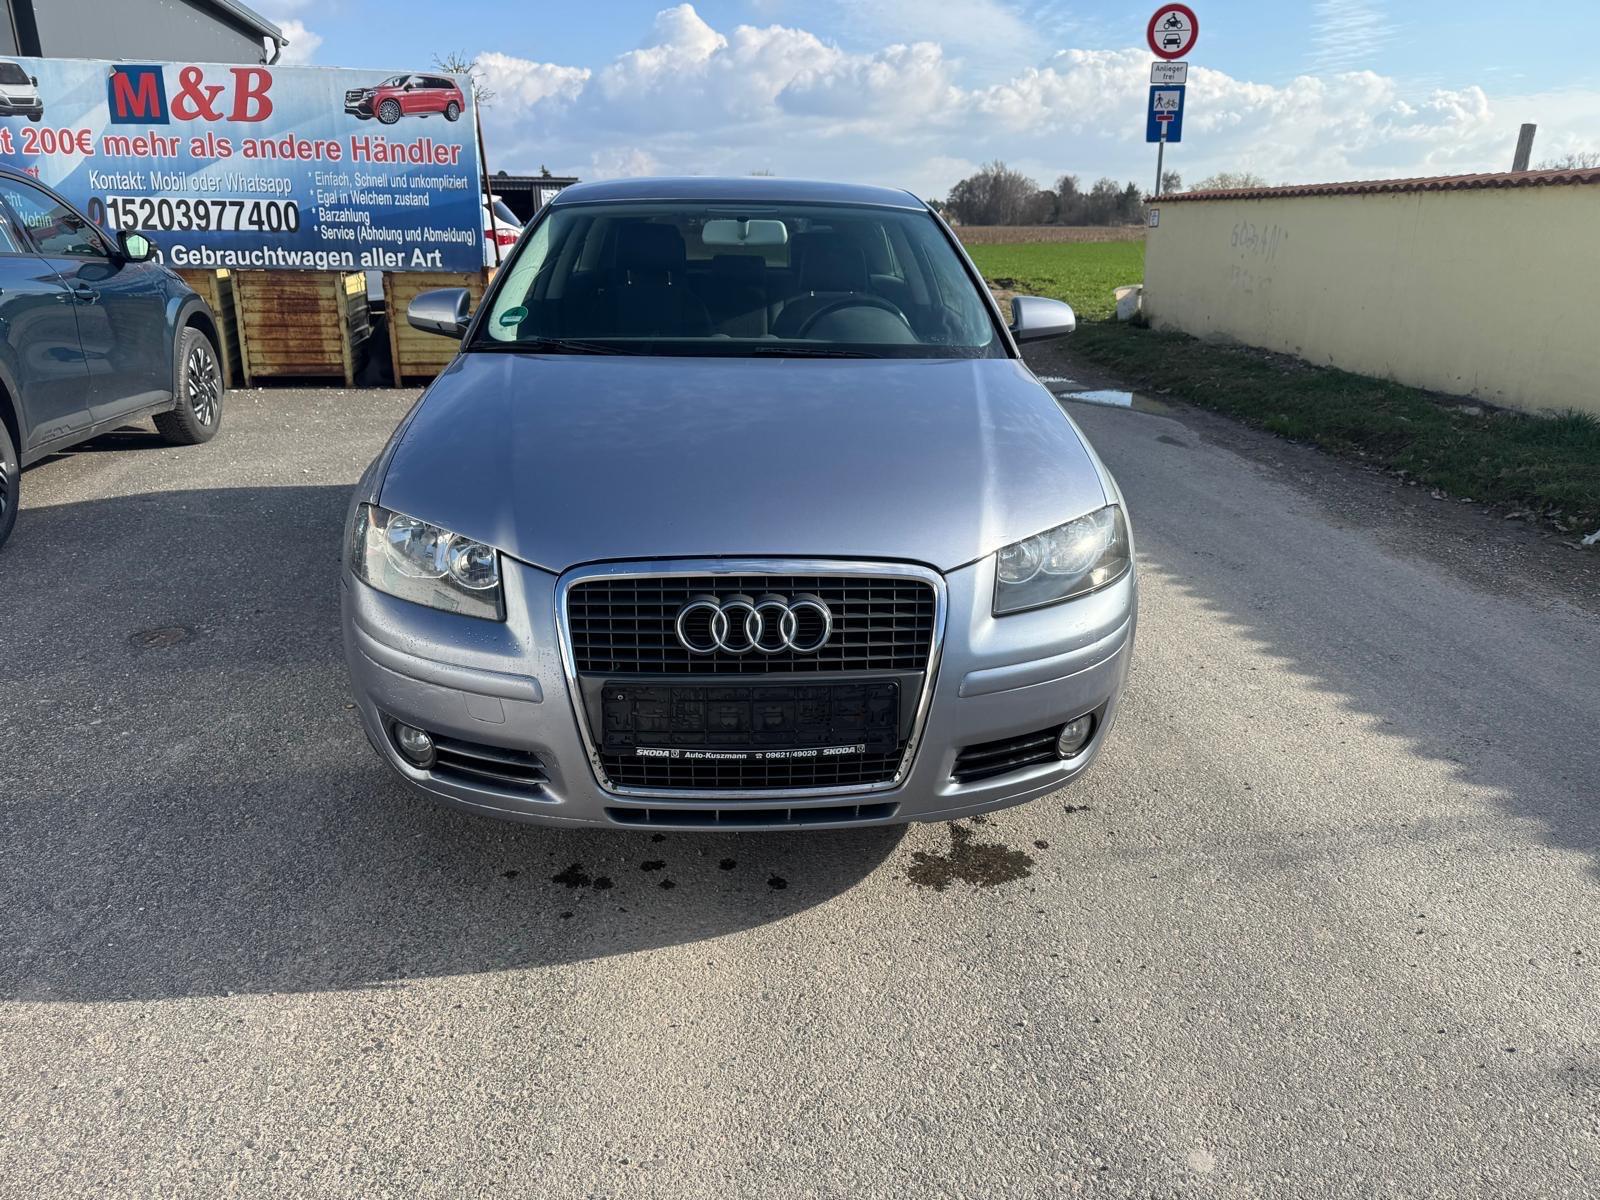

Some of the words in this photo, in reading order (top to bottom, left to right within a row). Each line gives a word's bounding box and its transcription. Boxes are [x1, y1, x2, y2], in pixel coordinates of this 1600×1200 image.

[1155, 64, 1184, 73] Anlieger
[1162, 72, 1175, 80] frei
[113, 66, 274, 123] M&B
[21, 127, 96, 156] 200€
[104, 131, 180, 157] mehr
[190, 132, 232, 158] als
[242, 133, 342, 162] andere
[351, 135, 462, 165] Händler
[89, 170, 146, 190] Kontakt:
[151, 171, 186, 191] Mobil
[192, 173, 221, 192] oder
[226, 172, 292, 197] Whatsapp
[314, 171, 352, 188] Einfach,
[354, 172, 388, 188] Schnell
[390, 174, 408, 188] und
[409, 175, 468, 192] unkompliziert
[316, 190, 337, 207] Egal
[339, 190, 349, 204] in
[350, 190, 393, 206] Welchem
[394, 192, 429, 206] zustand
[87, 196, 299, 233] 015203977400
[318, 207, 371, 225] Barzahlung
[321, 224, 355, 241] Service
[357, 227, 403, 244] (Abholung
[404, 227, 422, 242] und
[423, 227, 476, 246] Abmeldung)
[171, 244, 354, 270] Gebrauchtwagen
[360, 247, 405, 267] aller
[410, 248, 443, 268] Art
[684, 751, 747, 759] Auto-Kuszmann
